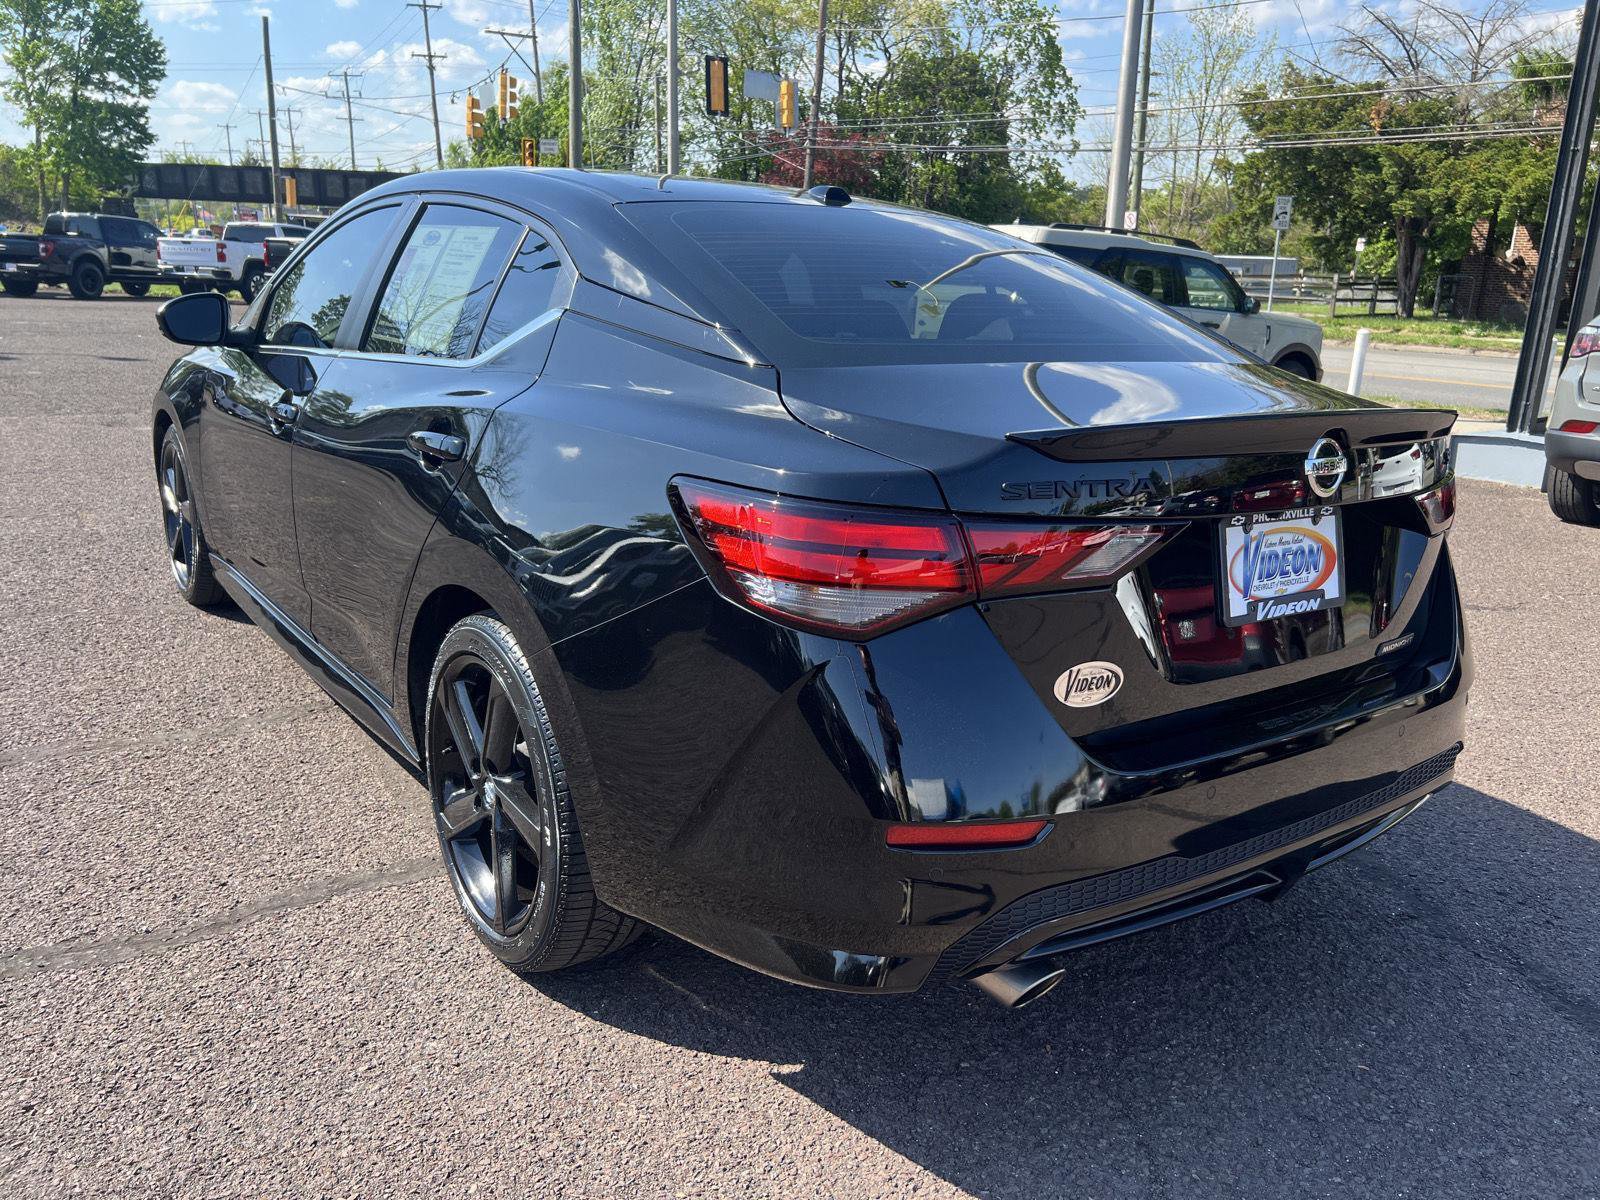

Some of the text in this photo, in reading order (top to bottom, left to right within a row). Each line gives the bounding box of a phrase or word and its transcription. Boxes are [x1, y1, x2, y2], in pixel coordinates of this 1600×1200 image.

[1000, 477, 1160, 502] SENTRA
[1252, 508, 1315, 523] PHOIXVILLE
[1243, 531, 1322, 600] VIDEON
[1257, 597, 1320, 621] VIDEON
[1064, 668, 1113, 702] VIDEON
